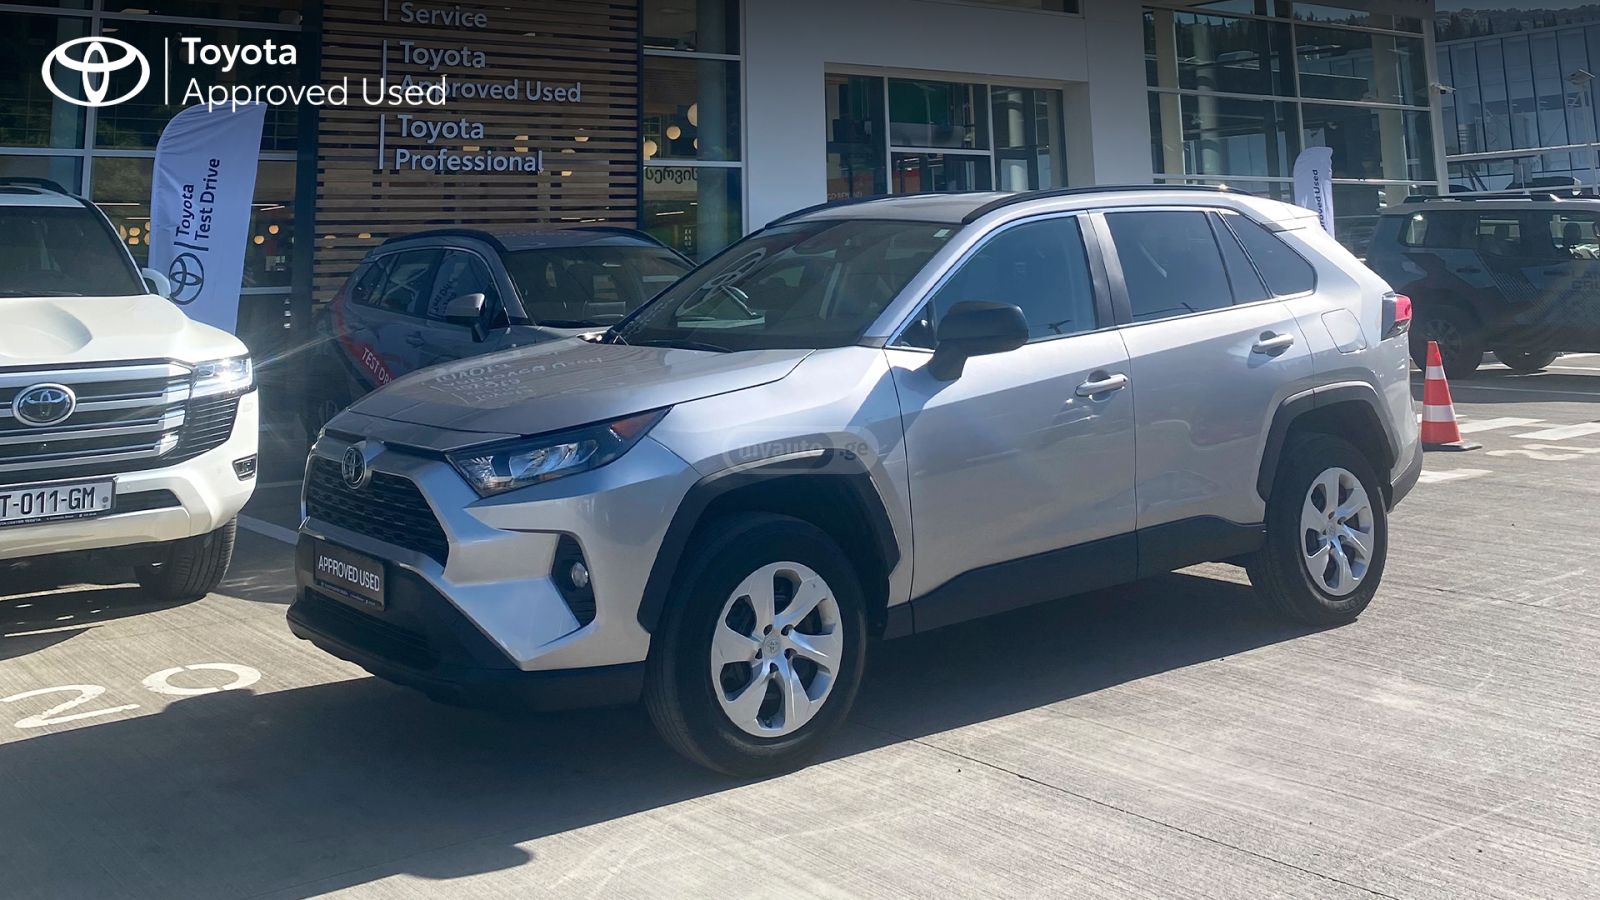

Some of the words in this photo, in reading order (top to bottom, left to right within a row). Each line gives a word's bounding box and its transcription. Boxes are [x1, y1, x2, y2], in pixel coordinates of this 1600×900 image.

[400, 2, 488, 28] Service
[400, 40, 486, 71] Toyota
[400, 75, 519, 103] Approved
[526, 80, 581, 103] Used
[397, 114, 484, 144] Toyota
[395, 148, 543, 175] Professional
[199, 158, 220, 204] Drive
[1312, 169, 1321, 194] Used
[175, 183, 195, 237] Toyota
[194, 206, 213, 241] Test
[361, 347, 380, 374] TEST
[318, 554, 359, 583] APPROVED
[359, 569, 380, 592] USED
